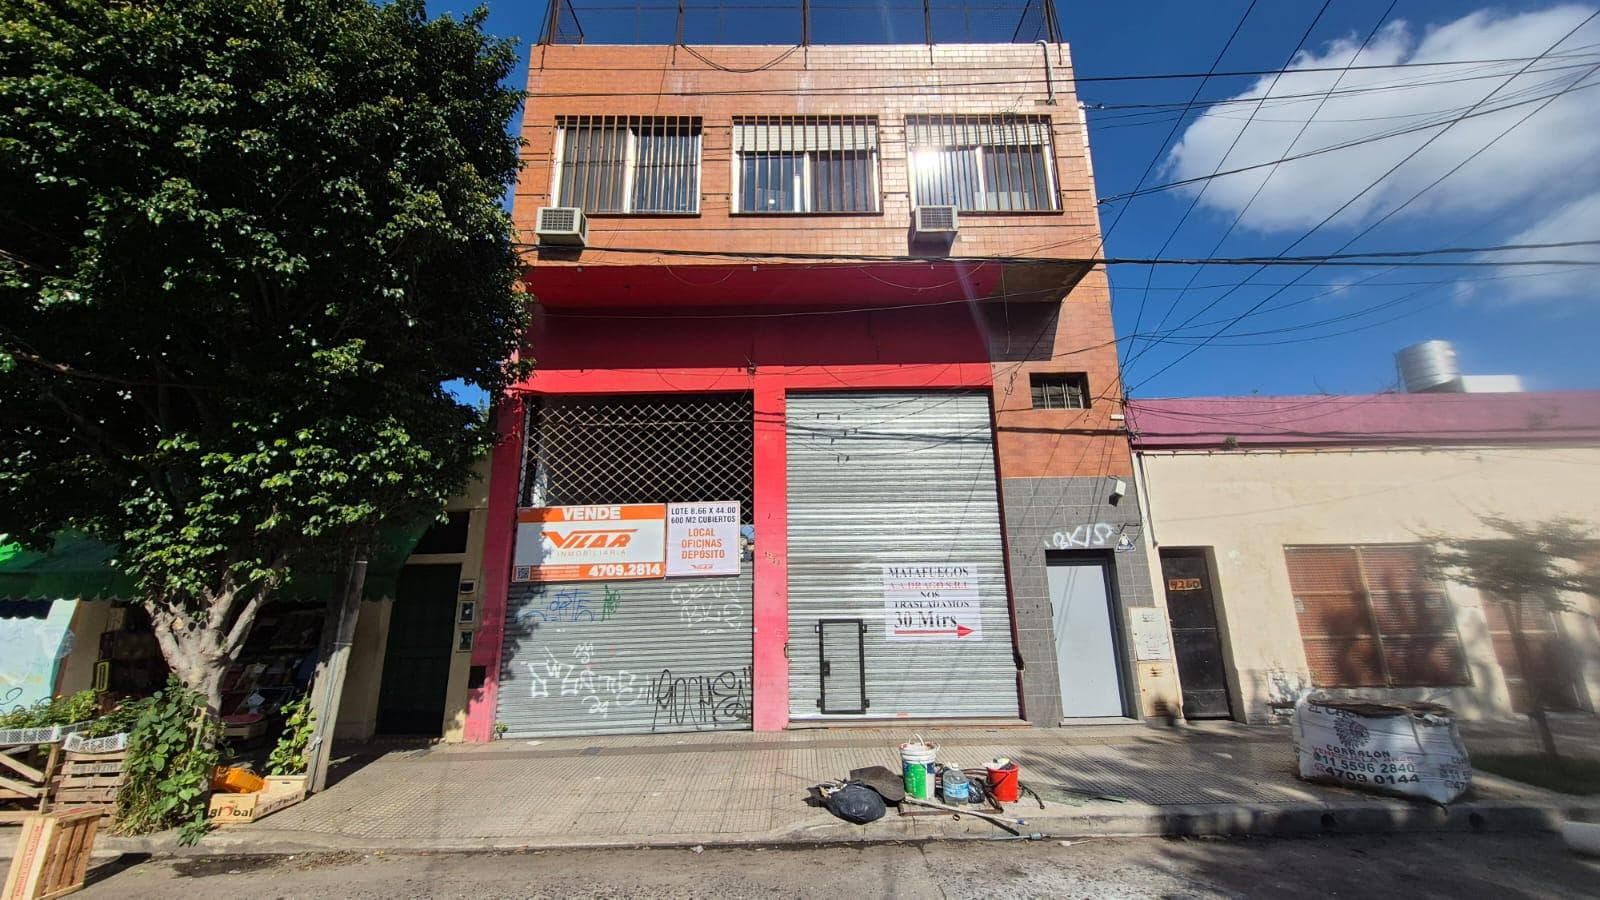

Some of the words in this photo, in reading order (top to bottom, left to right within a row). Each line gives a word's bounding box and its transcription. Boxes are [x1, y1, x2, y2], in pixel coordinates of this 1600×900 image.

[562, 507, 621, 520] VENDE
[671, 507, 688, 515] LOTE
[716, 506, 736, 514] 44.00
[671, 516, 684, 524] 600
[698, 515, 736, 523] CUBIERTOS
[688, 528, 715, 537] LOCAL
[541, 529, 638, 549] VILAR
[681, 538, 722, 548] OFICINAS
[557, 549, 626, 557] INMOBILIARIA
[889, 567, 969, 578] MATAFUEGOS
[894, 600, 970, 609] TRASLADAMOS
[894, 611, 913, 628] 30
[918, 610, 958, 628] Mtrs
[1326, 743, 1391, 758] CORRALON
[1341, 760, 1375, 773] 5596
[1380, 763, 1415, 774] 2840
[1326, 766, 1368, 783] 4709
[1374, 774, 1420, 785] 0144
